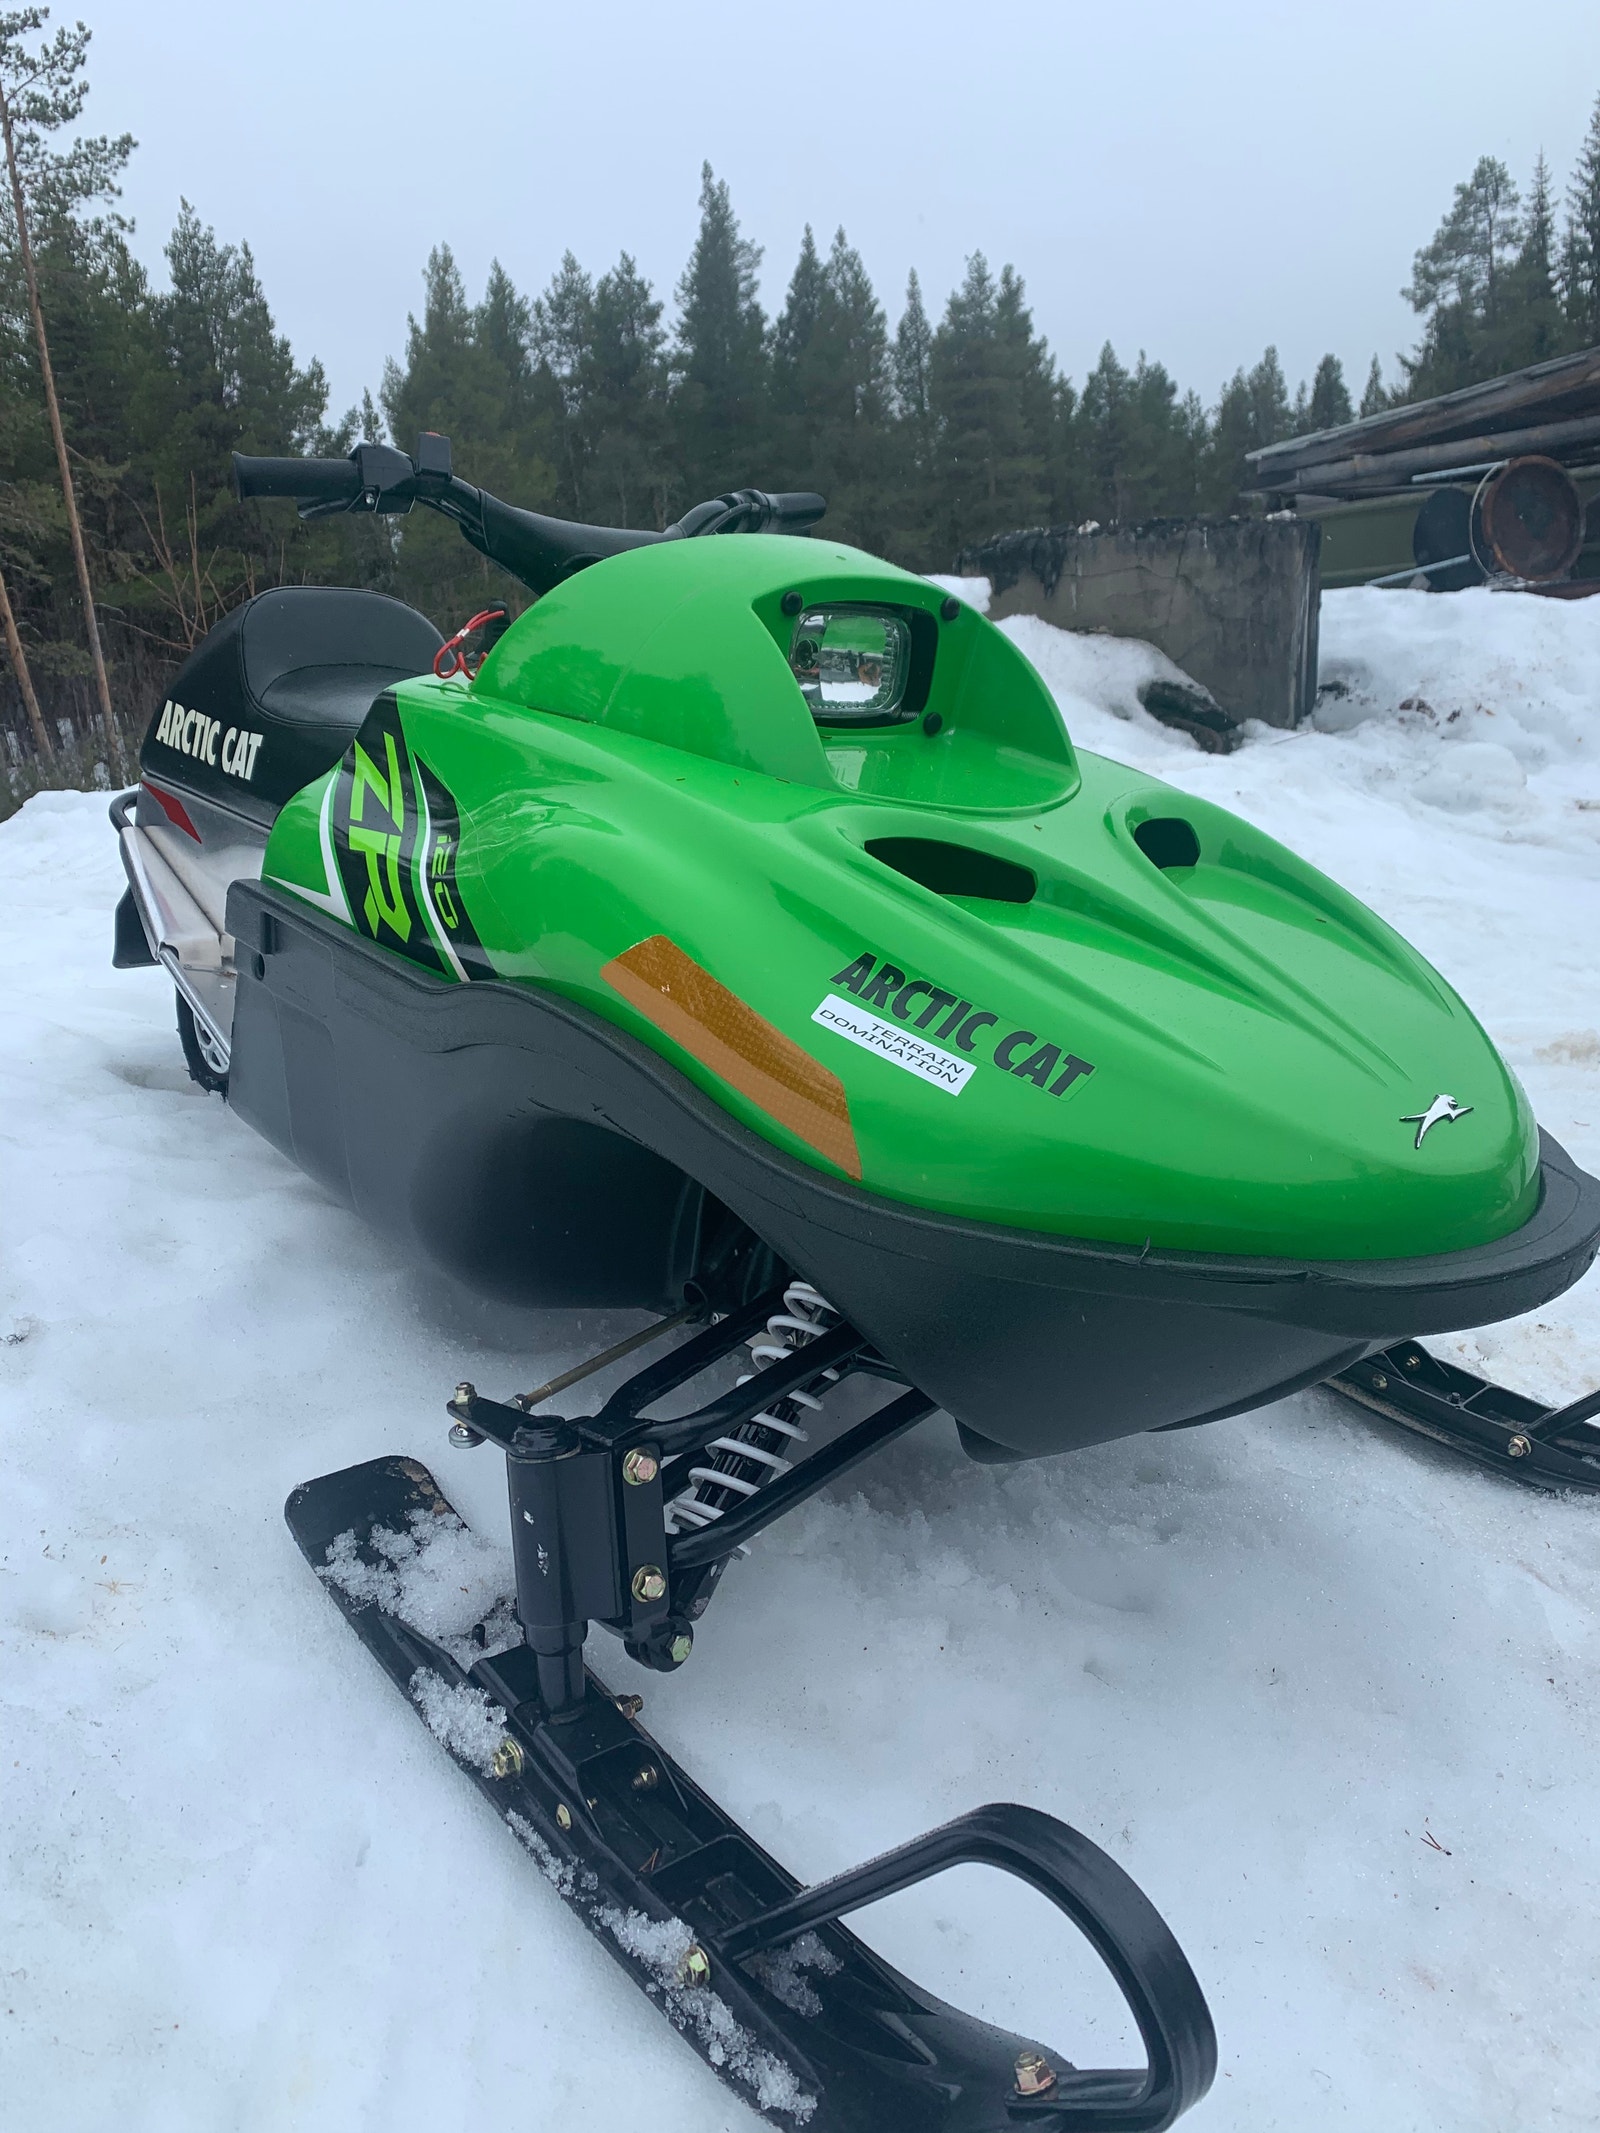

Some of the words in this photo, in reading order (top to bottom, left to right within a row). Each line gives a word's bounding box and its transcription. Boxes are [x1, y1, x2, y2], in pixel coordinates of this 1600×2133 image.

[155, 699, 221, 766] ARCTIC
[221, 726, 264, 781] CAT
[349, 731, 412, 943] ZR
[819, 1009, 958, 1084] DOMINATION
[829, 951, 999, 1052] ARCTIC
[993, 1030, 1096, 1097] CAT
[872, 1022, 964, 1074] TERRAIN
